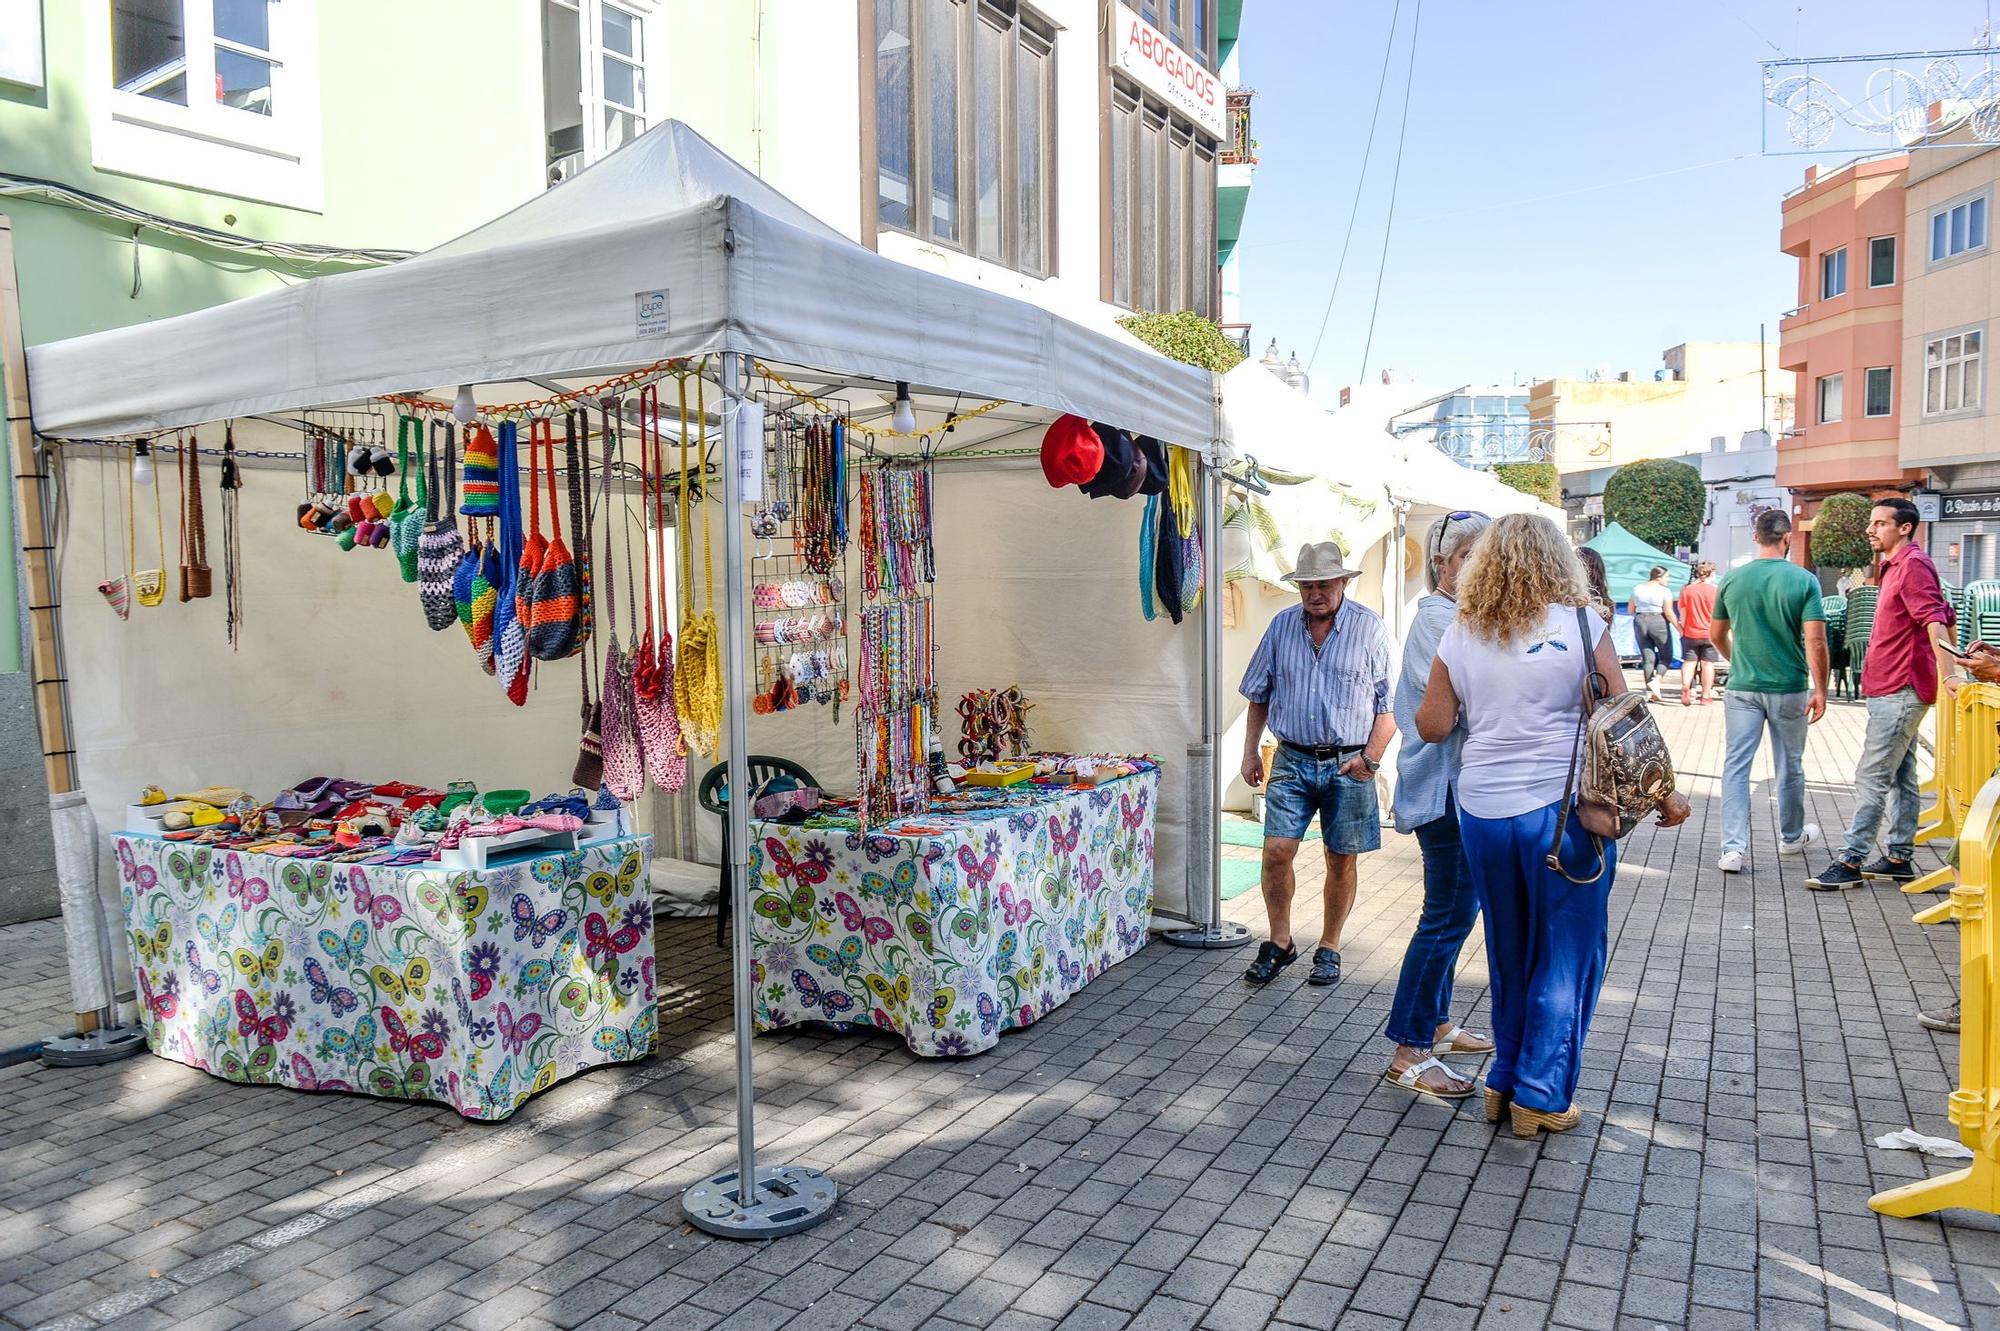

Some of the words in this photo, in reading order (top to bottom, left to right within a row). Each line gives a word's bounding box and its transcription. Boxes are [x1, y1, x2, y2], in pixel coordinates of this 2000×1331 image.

[1130, 21, 1214, 106] ABOGADOS
[1945, 499, 1954, 514] El
[1954, 499, 1981, 514] Rincón
[1982, 499, 1992, 511] de
